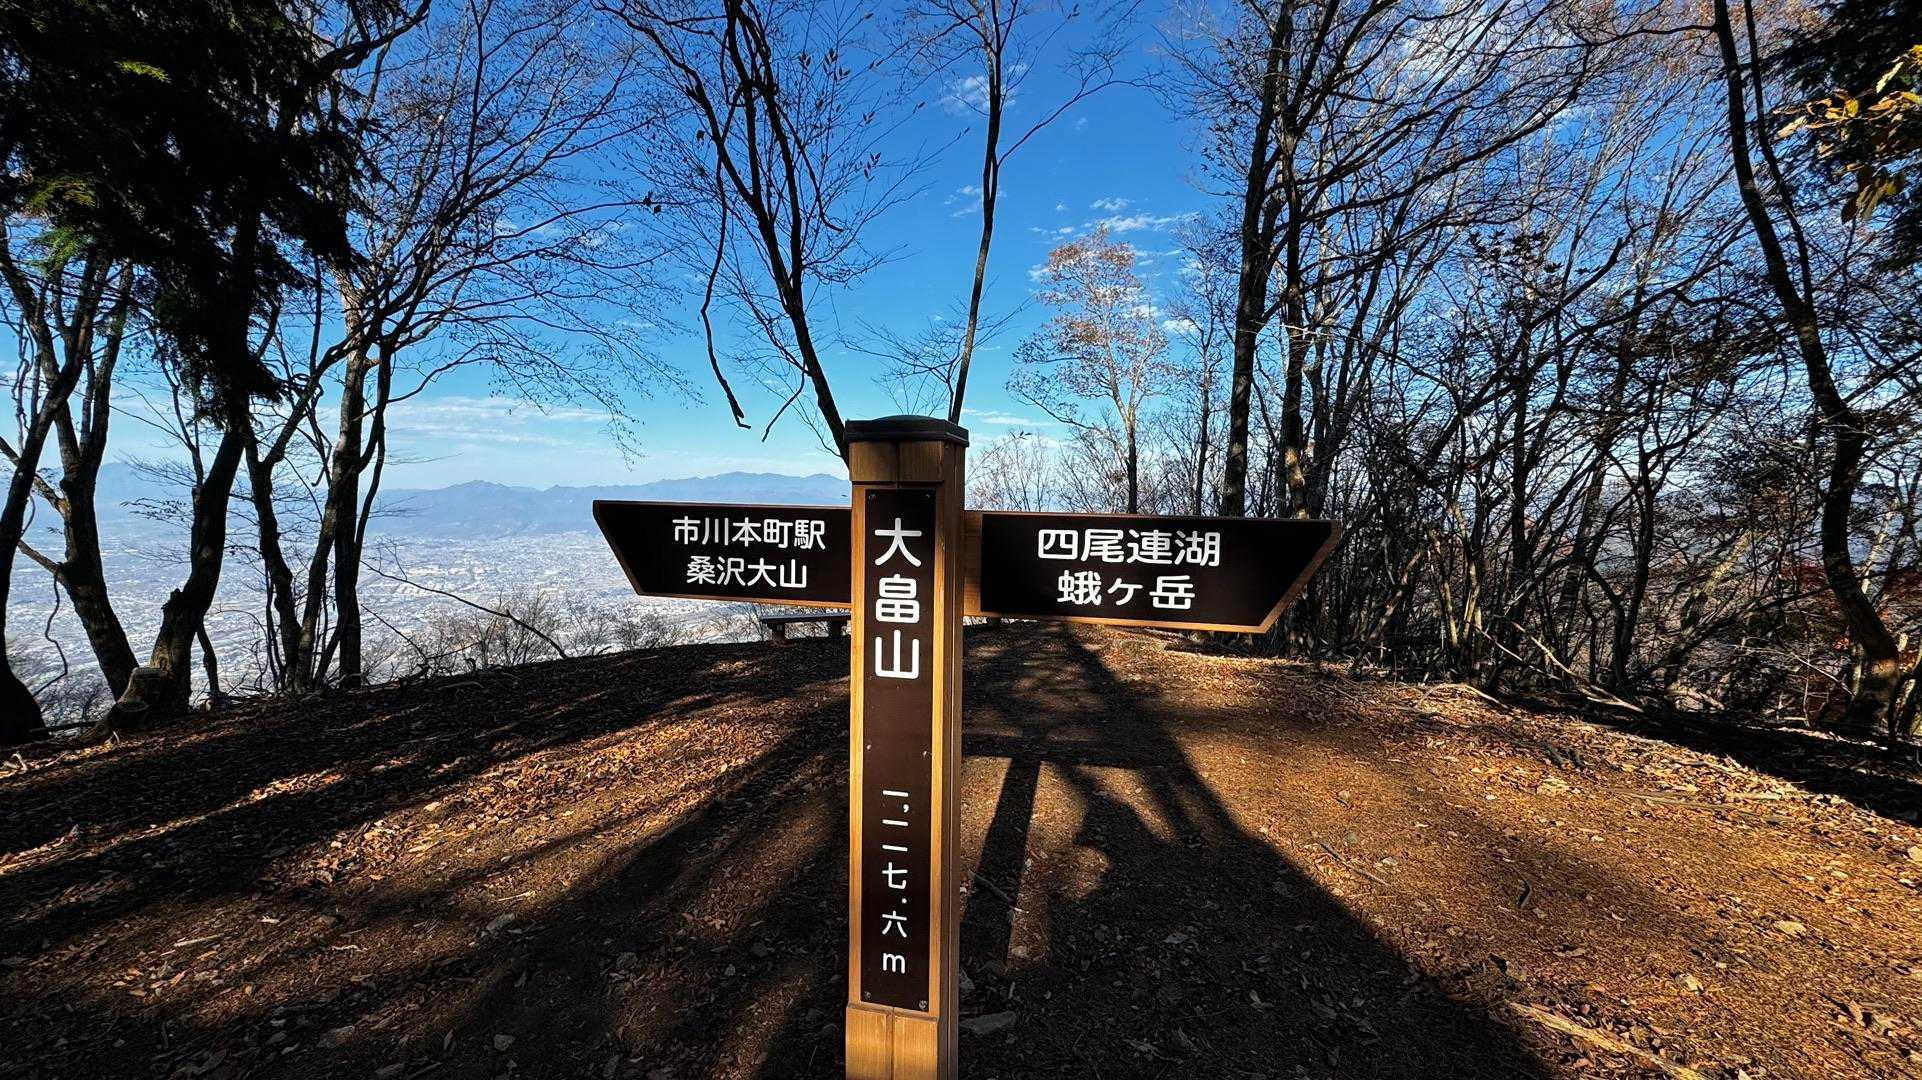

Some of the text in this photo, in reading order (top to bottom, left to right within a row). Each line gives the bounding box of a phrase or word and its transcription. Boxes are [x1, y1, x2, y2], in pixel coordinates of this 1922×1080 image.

[672, 515, 826, 550] 市川本町駅
[1037, 528, 1221, 567] 四尾連湖
[686, 555, 807, 589] 桑沢大山
[874, 517, 922, 680] 大畠山
